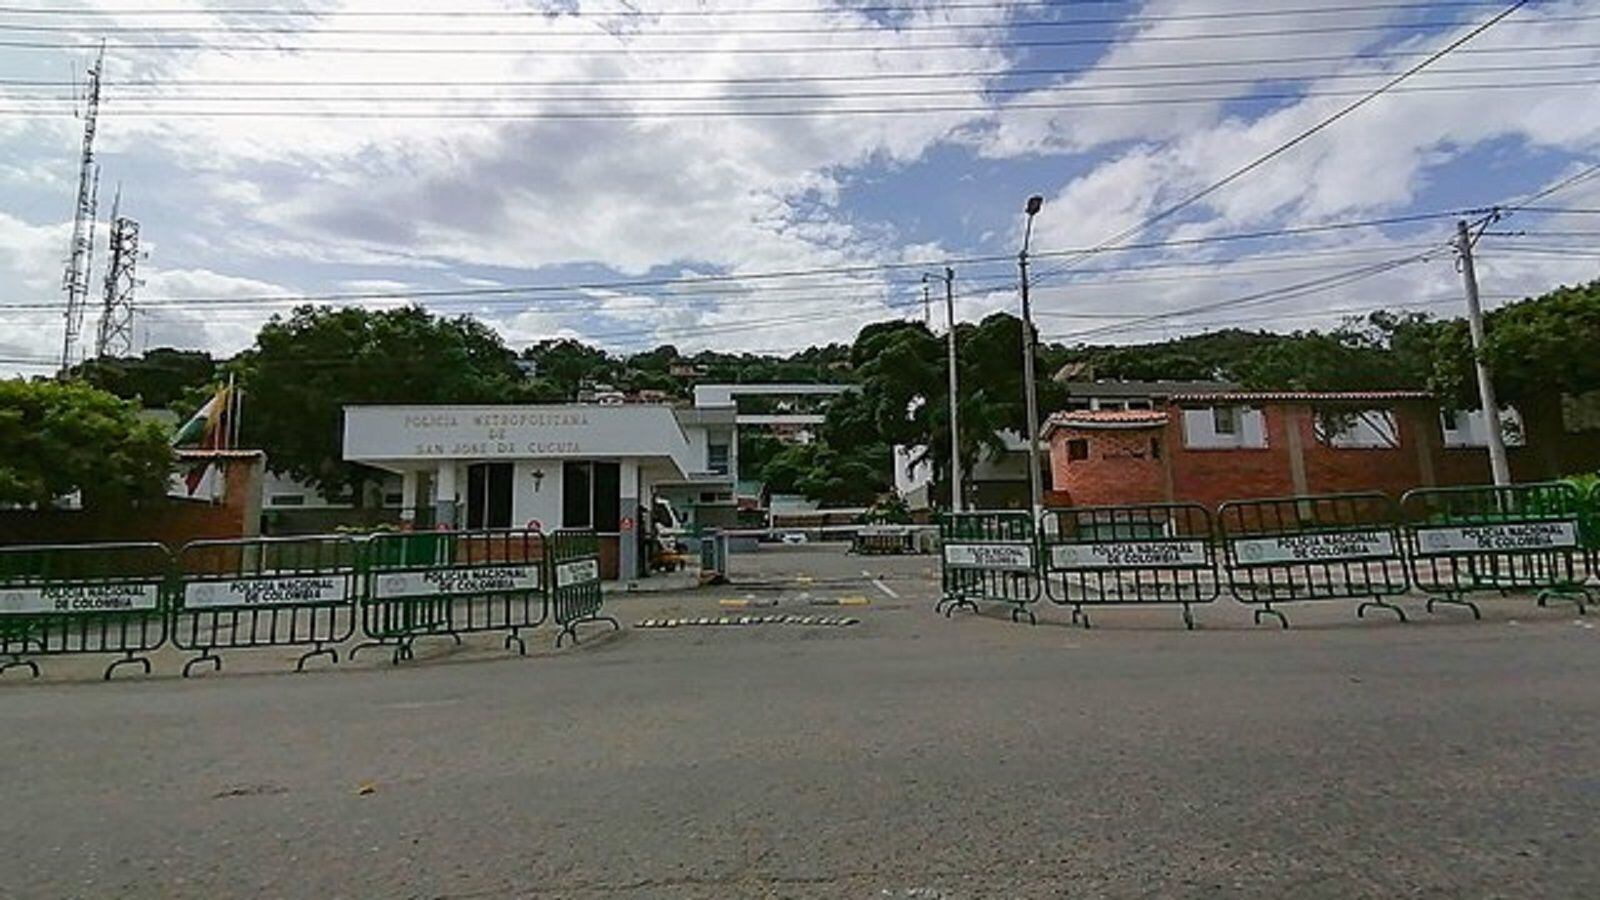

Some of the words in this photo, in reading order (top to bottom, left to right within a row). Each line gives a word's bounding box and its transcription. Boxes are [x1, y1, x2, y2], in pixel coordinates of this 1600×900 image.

[474, 413, 589, 426] METROPOLITANA
[489, 429, 505, 440] DE
[416, 443, 444, 455] SAN
[498, 443, 515, 453] DE
[1508, 524, 1564, 535] NACIONAL
[1323, 532, 1380, 543] NACIONAL
[1478, 536, 1493, 548] DE
[1495, 534, 1554, 547] COLOMBIA
[1137, 541, 1193, 553] NACIONAL
[1292, 549, 1308, 558] DE
[1310, 545, 1370, 557] COLOMBIA
[1107, 553, 1120, 563] DE
[1125, 553, 1181, 563] COLOMBIA
[472, 569, 527, 579] NACIONAL
[88, 584, 146, 596] NACIONAL
[278, 579, 334, 589] NACIONAL
[439, 581, 452, 592] DE
[457, 579, 516, 590] COLOMBIA
[245, 592, 258, 603] DE
[263, 590, 321, 600] COLOMBIA
[55, 599, 69, 609] DE
[73, 597, 133, 609] COLOMBIA
